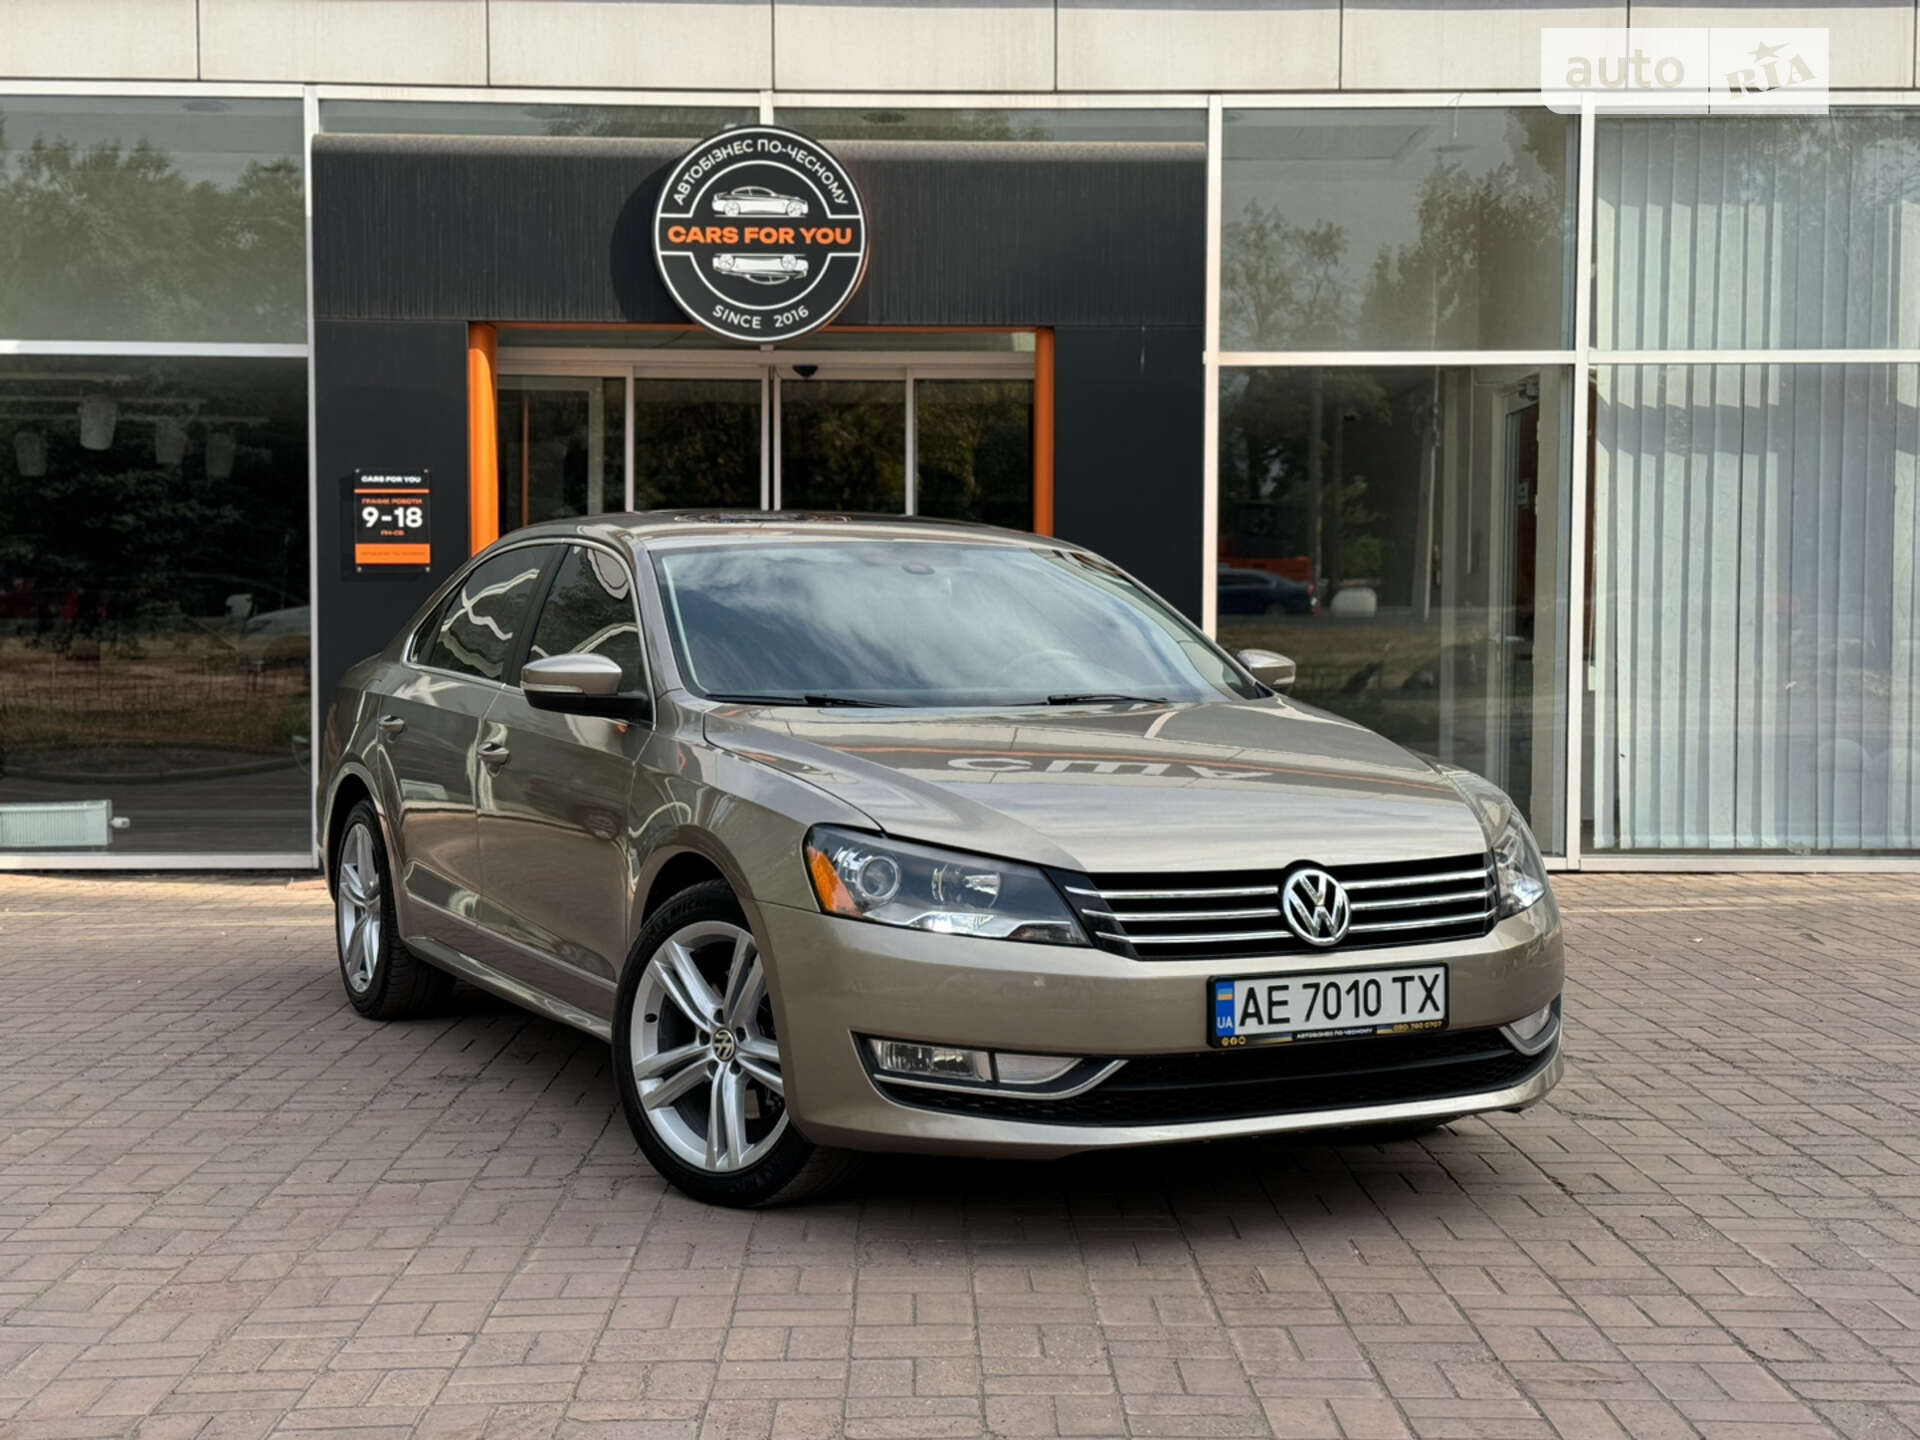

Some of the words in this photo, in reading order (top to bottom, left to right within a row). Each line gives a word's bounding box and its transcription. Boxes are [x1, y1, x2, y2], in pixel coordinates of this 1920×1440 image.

[672, 139, 754, 206] АВТОБІЗНЕС
[757, 139, 850, 206] ПО-ЧЕСНОМУ
[667, 225, 739, 245] CARS
[744, 226, 795, 245] FOR
[799, 226, 853, 245] YOU
[712, 304, 763, 329] SINCE
[773, 304, 810, 328] 2016
[361, 475, 385, 483] CARS
[385, 475, 402, 483] FOR
[404, 475, 422, 483] YOU
[361, 506, 423, 528] 9-18
[1238, 984, 1291, 1027] AE
[1302, 978, 1382, 1023] 7010
[1392, 974, 1441, 1015] TX
[1217, 1015, 1233, 1029] UA
